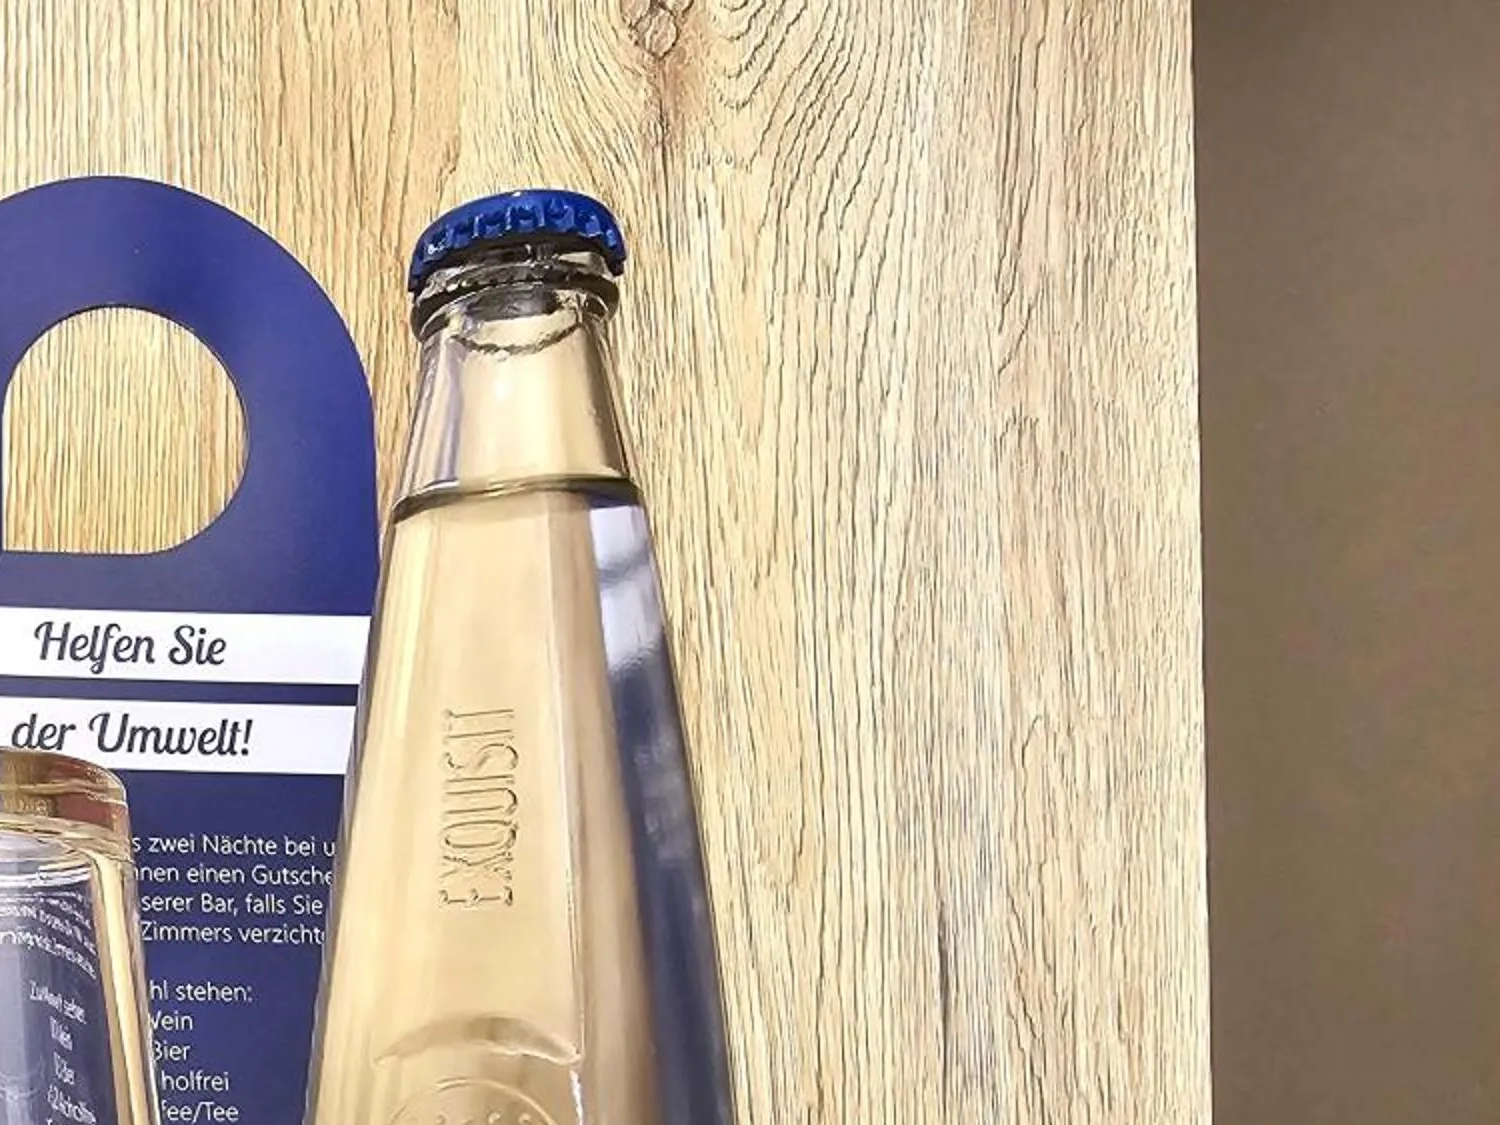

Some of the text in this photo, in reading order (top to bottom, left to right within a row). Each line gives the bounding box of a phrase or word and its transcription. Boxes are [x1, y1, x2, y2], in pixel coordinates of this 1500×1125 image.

[34, 621, 227, 675] Helfen Sie
[11, 712, 253, 757] der Umwelt!
[149, 834, 195, 853] zwei
[202, 834, 277, 856] Nächte
[285, 836, 315, 856] bei
[187, 864, 245, 884] einen
[201, 893, 238, 916] Bar,
[246, 893, 286, 914] falls
[293, 894, 323, 914] Sie
[141, 921, 233, 941] Zimmers
[175, 981, 253, 1002] stehen:
